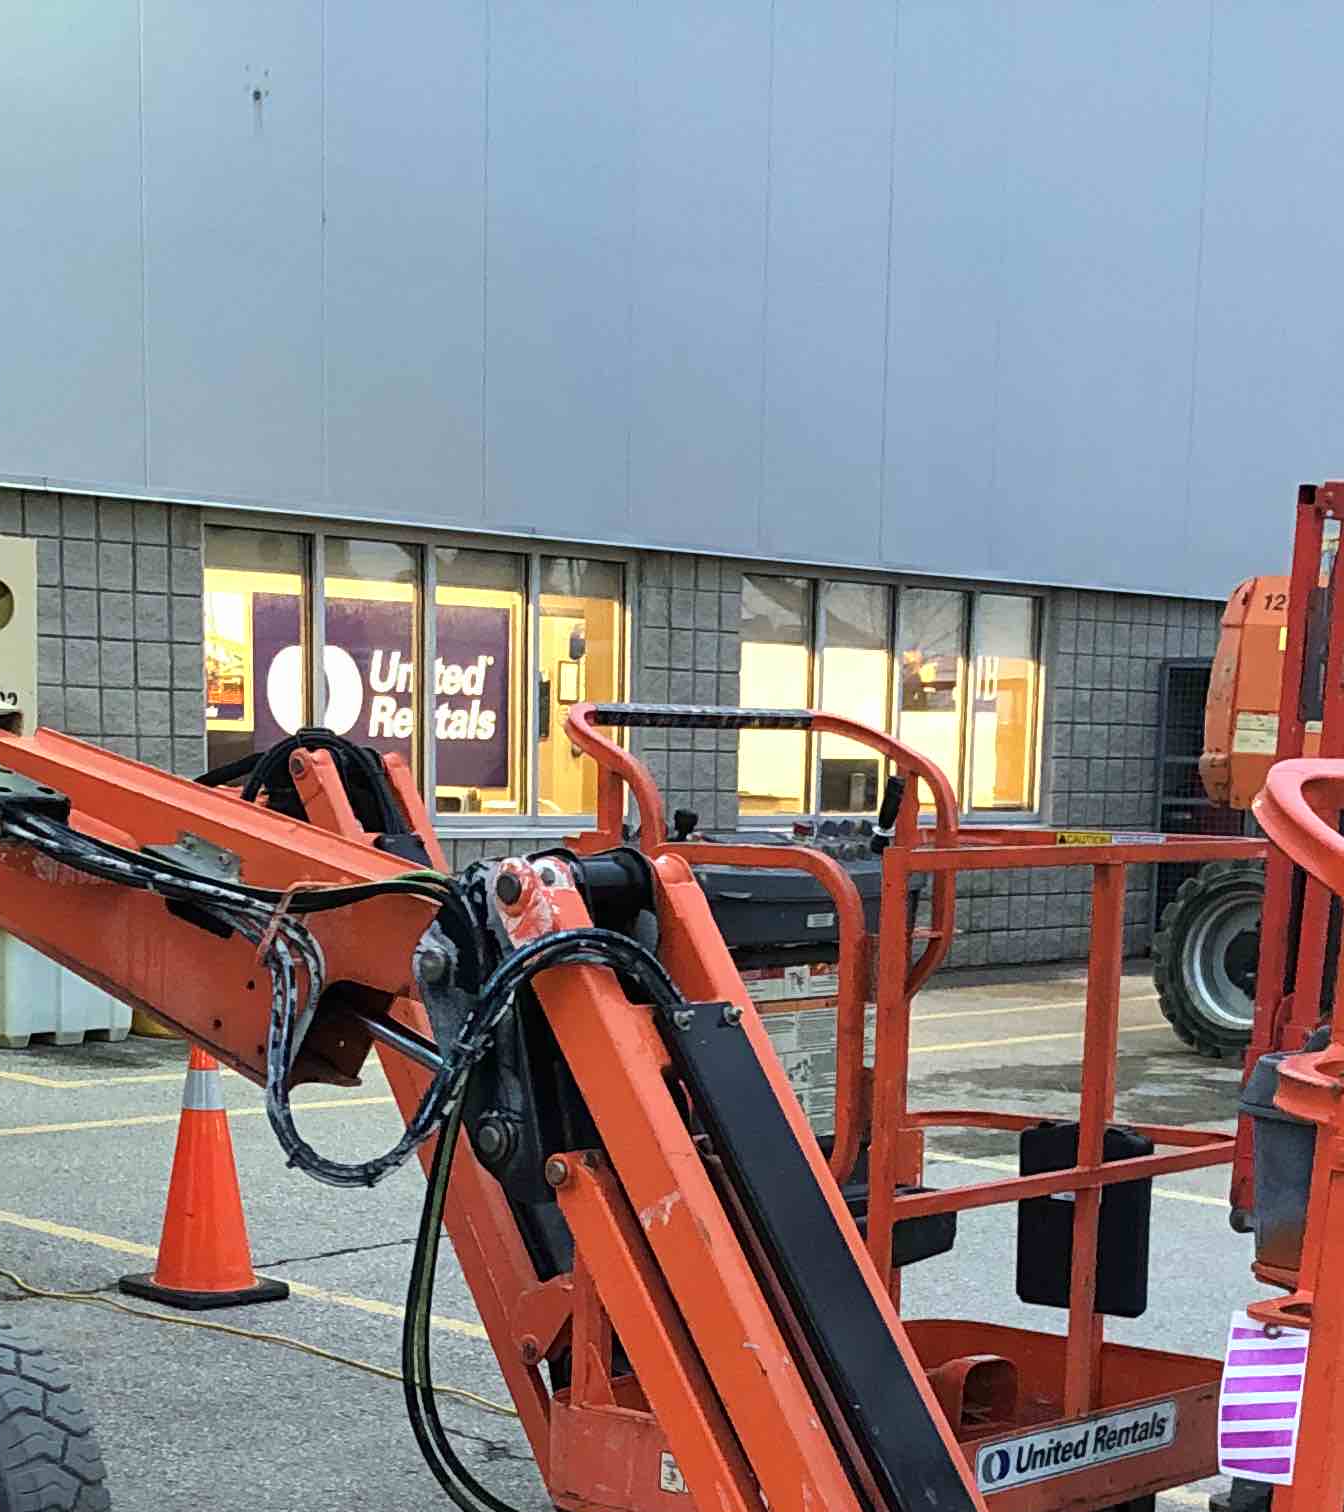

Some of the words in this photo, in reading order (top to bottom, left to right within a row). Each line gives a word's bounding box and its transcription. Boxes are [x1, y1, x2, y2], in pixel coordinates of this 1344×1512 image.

[369, 649, 488, 696] Unted
[368, 695, 497, 740] Retals
[1015, 1430, 1089, 1474] United
[1093, 1411, 1169, 1454] Rentals
